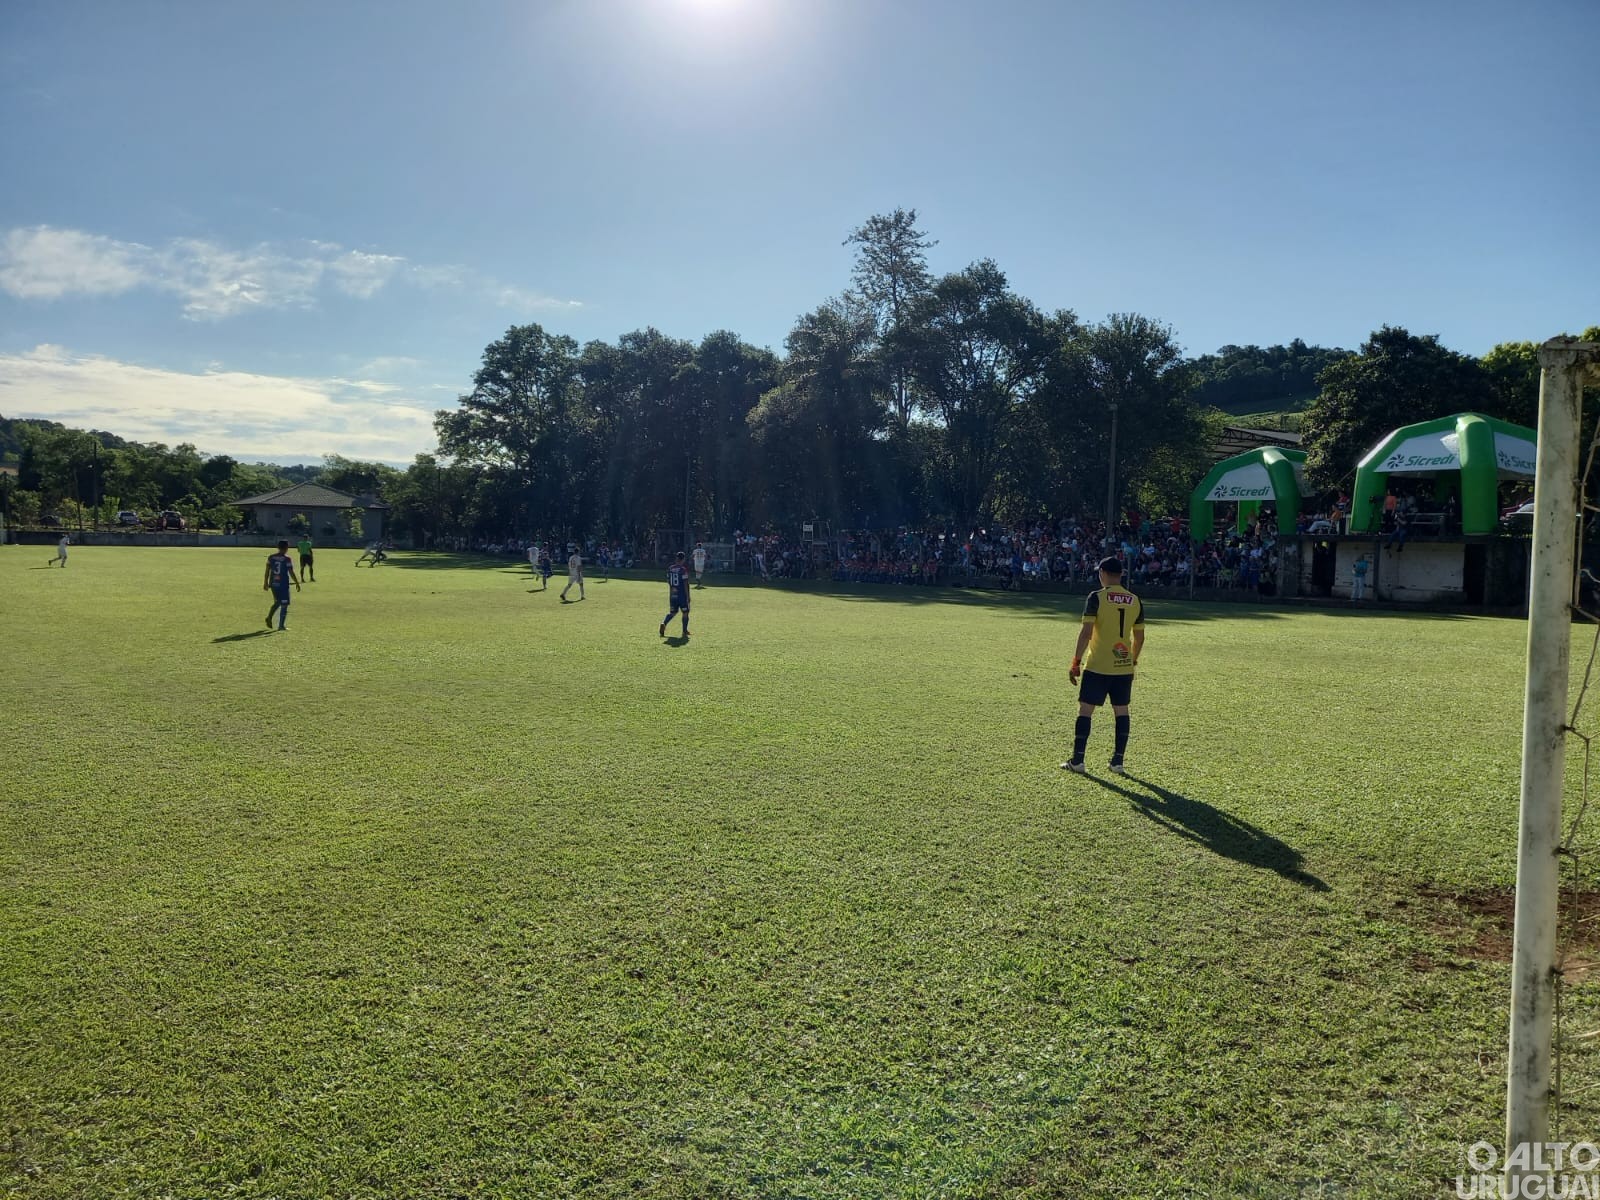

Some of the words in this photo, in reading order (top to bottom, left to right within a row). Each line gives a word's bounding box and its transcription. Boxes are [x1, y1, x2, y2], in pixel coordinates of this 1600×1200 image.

[1405, 454, 1455, 466] Sicredi
[1229, 486, 1270, 497] Sicredi
[273, 562, 281, 575] 3
[670, 573, 679, 586] 18
[1118, 608, 1125, 638] 1
